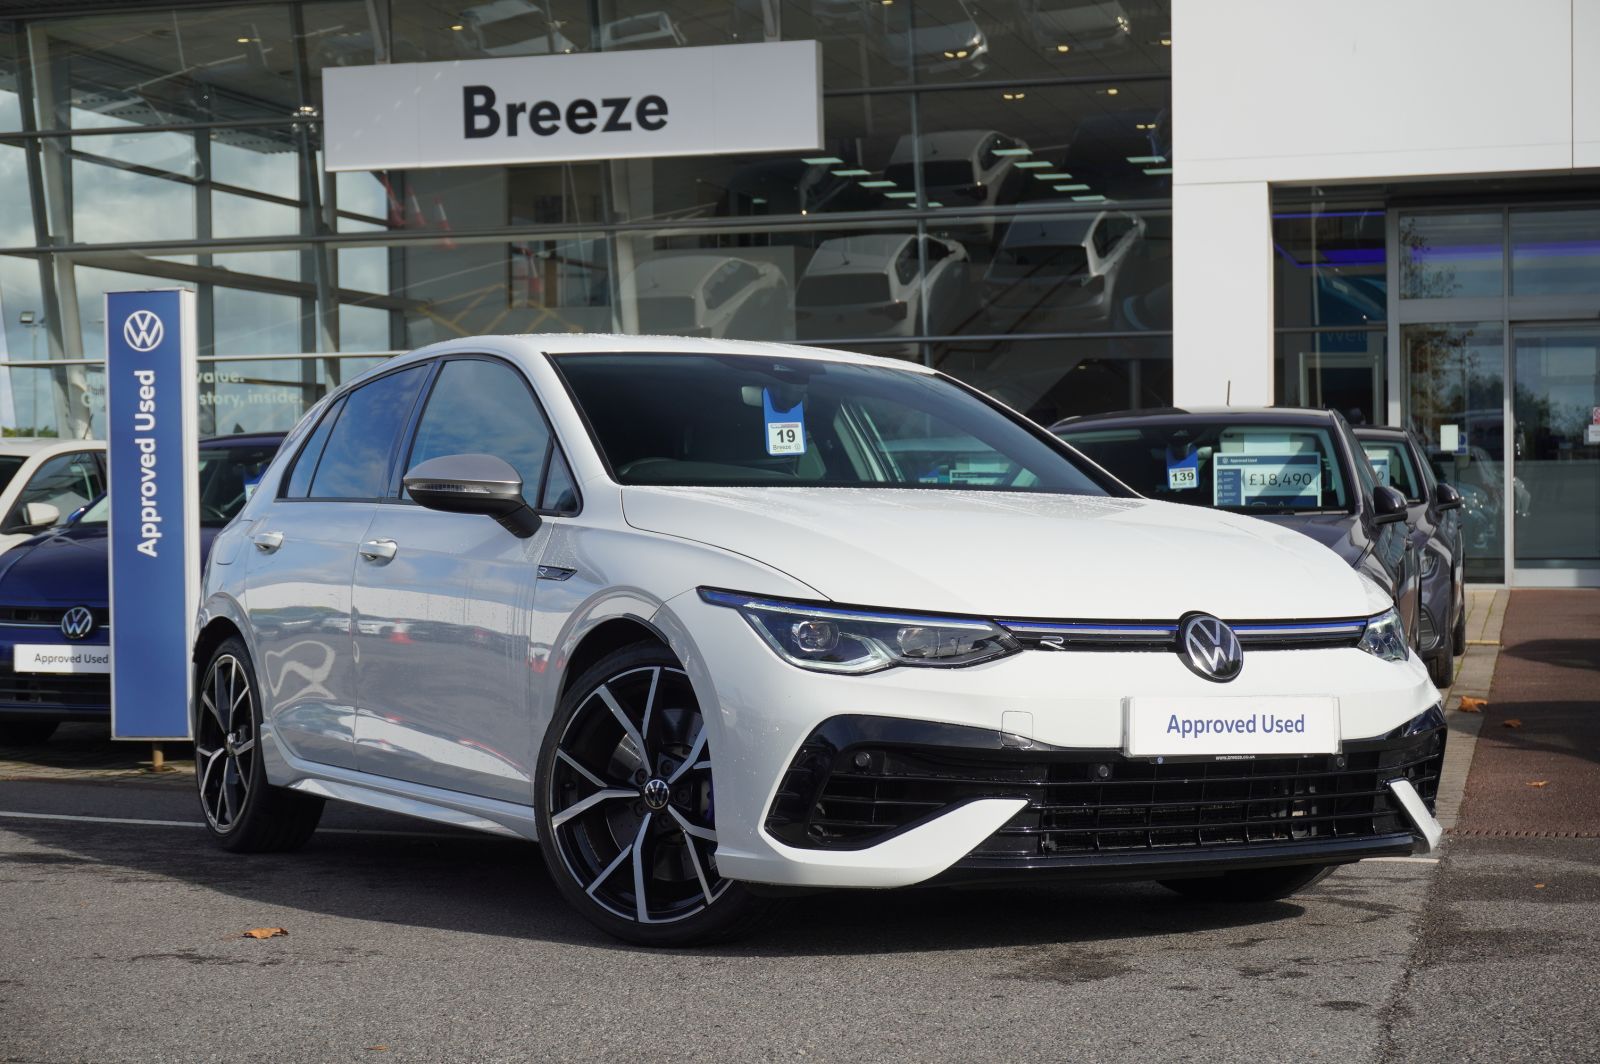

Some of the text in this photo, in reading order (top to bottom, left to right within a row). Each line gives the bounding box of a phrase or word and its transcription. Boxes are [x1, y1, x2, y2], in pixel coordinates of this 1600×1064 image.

[462, 84, 669, 139] Breeze
[247, 389, 304, 405] inside.
[777, 429, 796, 443] 19
[134, 370, 162, 558] Approved Used
[1171, 472, 1194, 482] 139
[1249, 473, 1312, 487] £18,490
[34, 653, 109, 665] Approved Used
[1166, 713, 1305, 738] Approved Used
